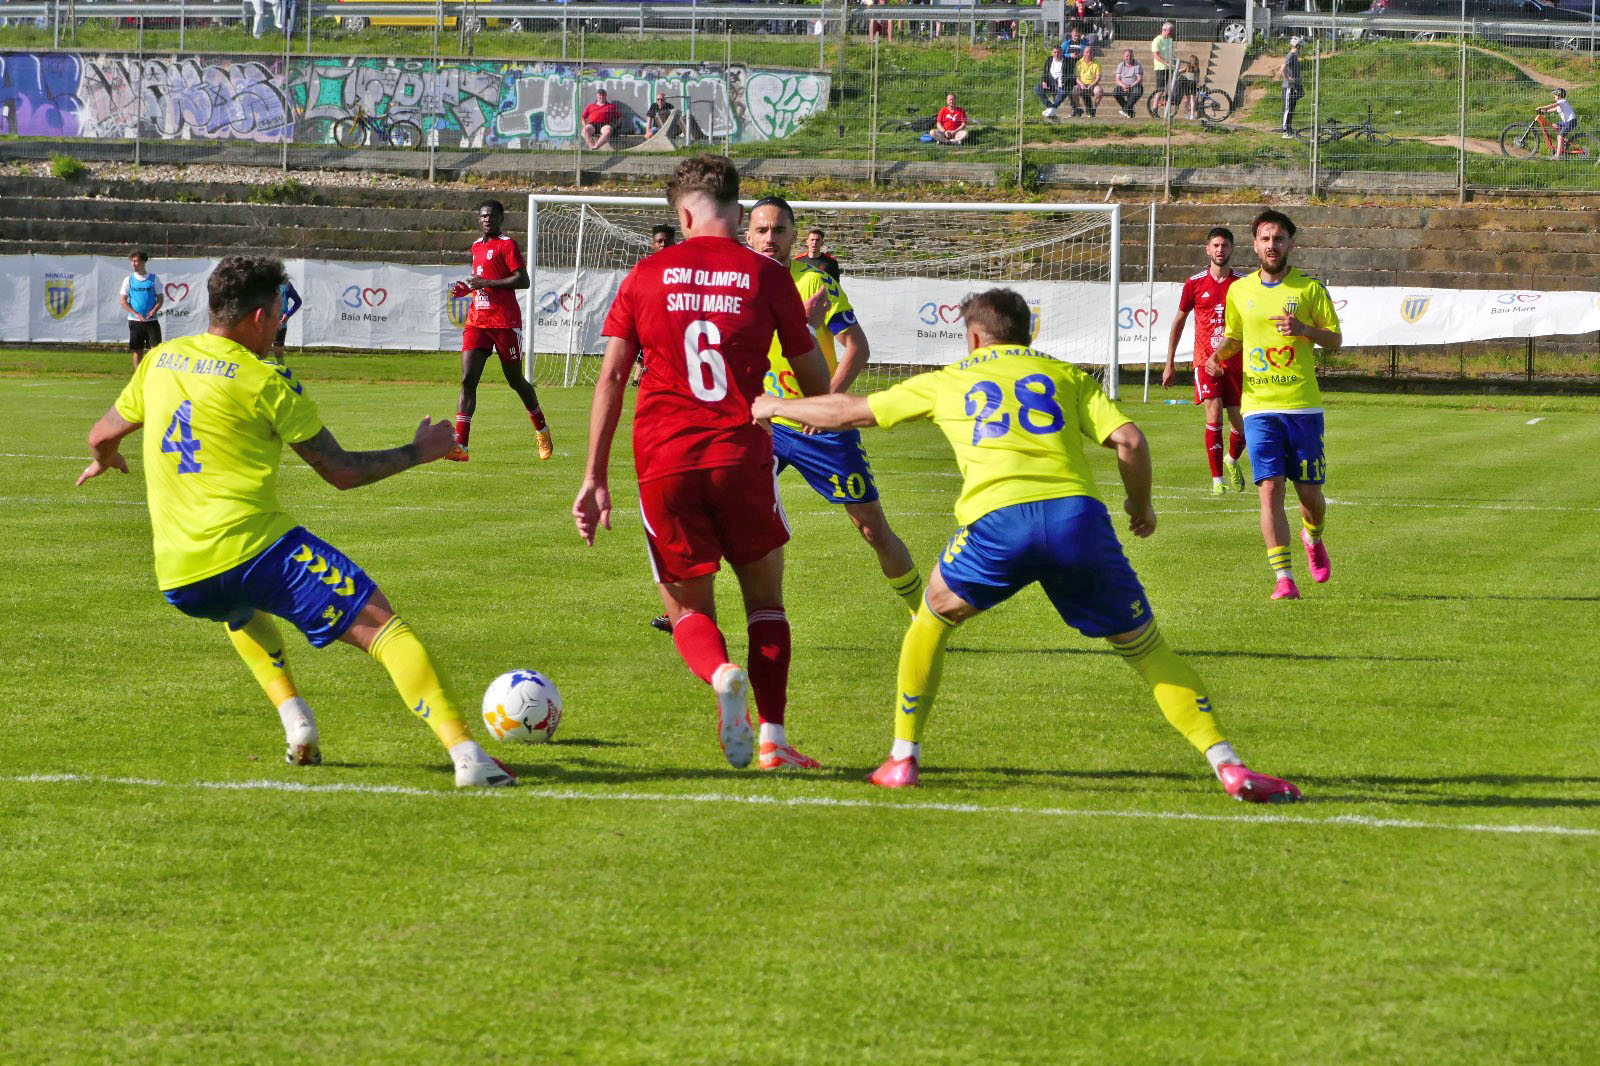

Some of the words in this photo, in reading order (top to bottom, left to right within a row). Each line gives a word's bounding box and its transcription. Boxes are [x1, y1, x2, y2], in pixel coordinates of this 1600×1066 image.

[663, 268, 692, 284] CSM
[695, 270, 750, 289] OLIMPIA
[166, 309, 190, 317] Mare
[667, 293, 701, 312] SATU
[702, 294, 743, 314] MARE
[1513, 305, 1536, 313] Mare
[341, 313, 361, 321] Baia
[364, 314, 387, 322] Mare
[538, 319, 558, 327] Baia
[917, 329, 937, 338] Baia
[939, 330, 963, 339] Mare
[1118, 334, 1131, 342] aia
[156, 353, 189, 369] BAIA
[191, 359, 240, 379] MARE
[684, 320, 728, 402] 6
[960, 350, 999, 370] BAIA
[1249, 376, 1269, 386] Baia
[1271, 374, 1298, 384] Mare
[964, 373, 1066, 447] 28
[161, 399, 202, 475] 4
[1299, 458, 1321, 481] 11
[829, 472, 866, 499] 10
